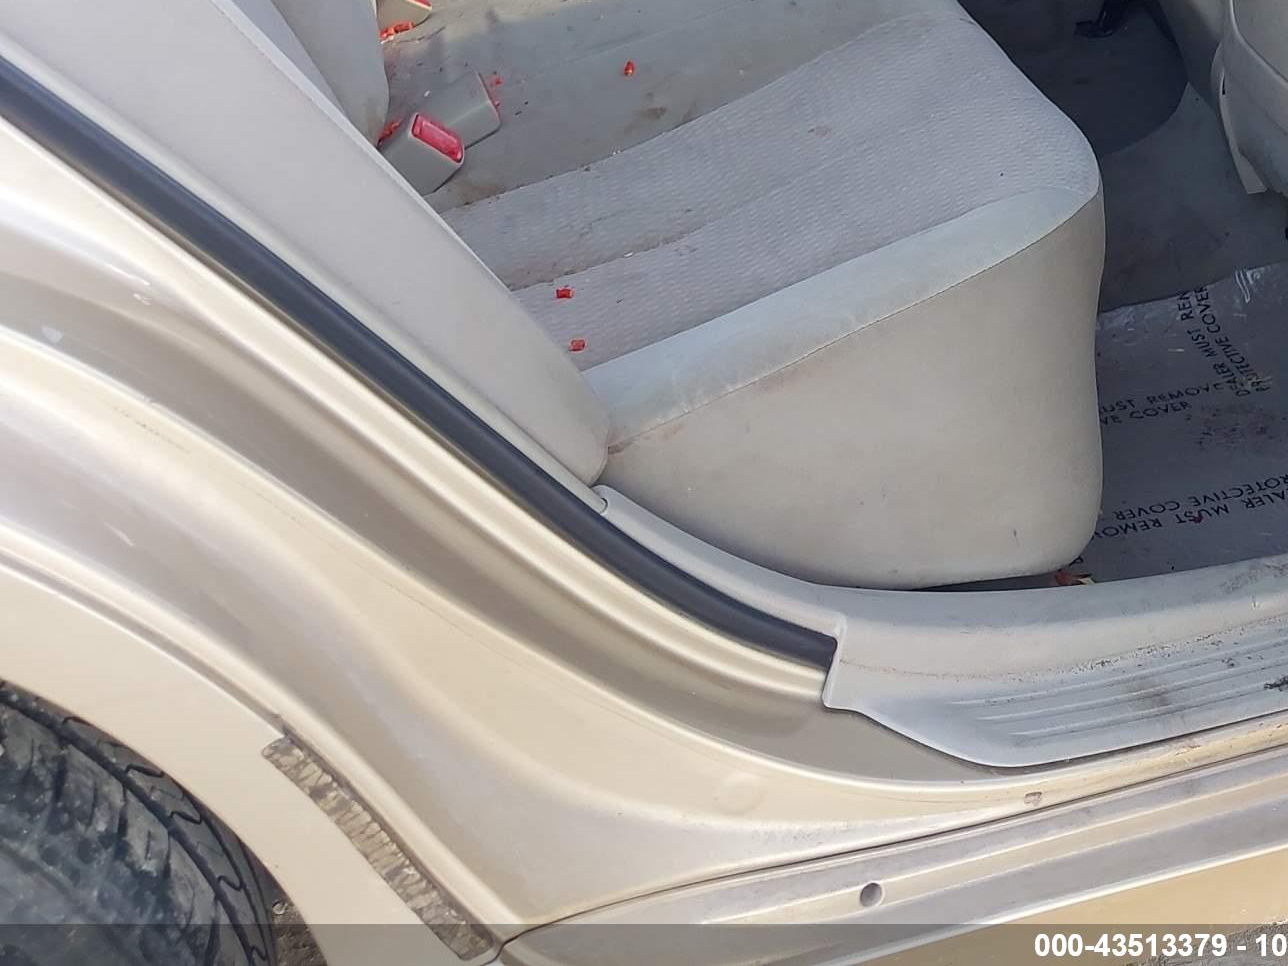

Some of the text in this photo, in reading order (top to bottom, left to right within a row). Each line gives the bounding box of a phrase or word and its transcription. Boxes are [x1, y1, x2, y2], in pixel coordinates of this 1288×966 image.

[1187, 328, 1217, 358] MUST
[1101, 398, 1136, 413] UST
[1129, 401, 1192, 420] COVER
[1113, 500, 1180, 521] COVER
[1176, 504, 1231, 524] MUST
